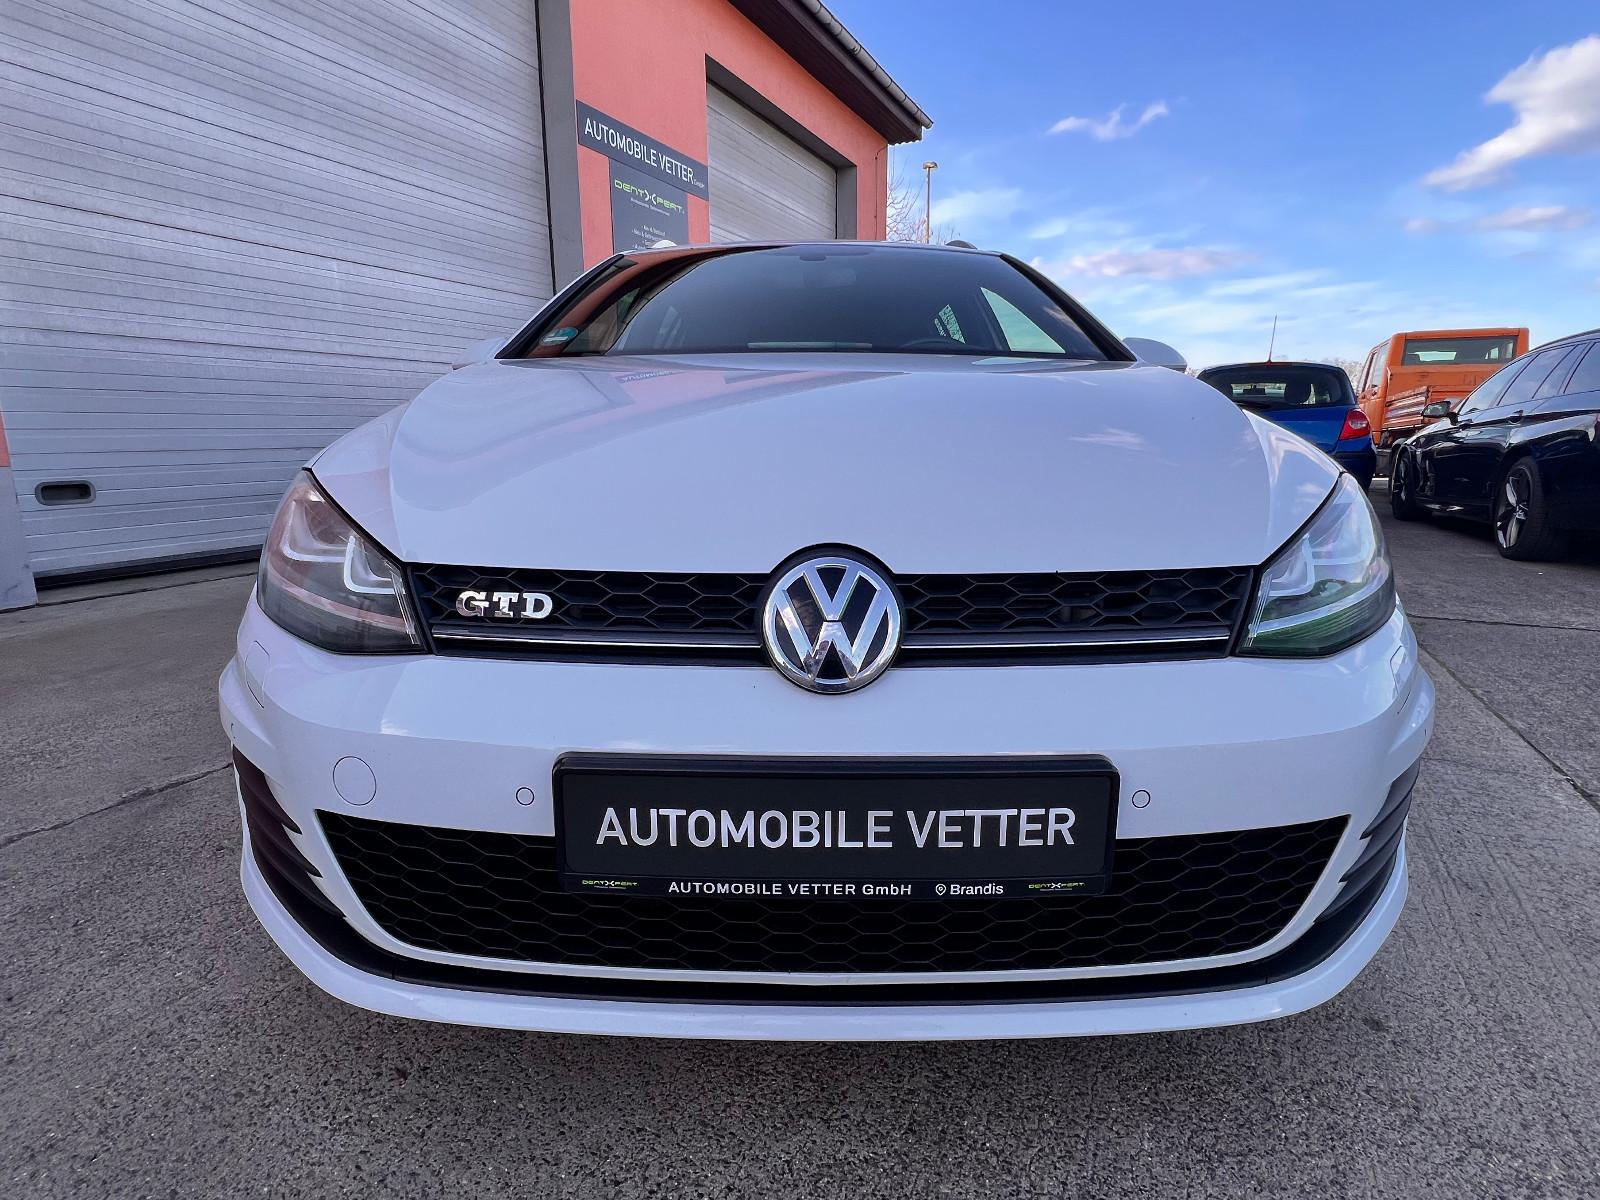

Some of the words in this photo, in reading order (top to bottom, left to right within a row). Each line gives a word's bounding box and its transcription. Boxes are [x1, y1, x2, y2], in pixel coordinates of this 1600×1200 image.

[584, 117, 658, 168] AUTOMOBILE
[658, 152, 694, 185] VETTER
[455, 590, 554, 619] GTD
[596, 807, 894, 849] AUTOMOBILE
[906, 807, 1076, 849] VETTER
[668, 881, 782, 895] AUTOMOBILE
[787, 883, 856, 896] VETTER
[862, 883, 912, 896] GmbH
[949, 883, 1004, 895] Brandis
